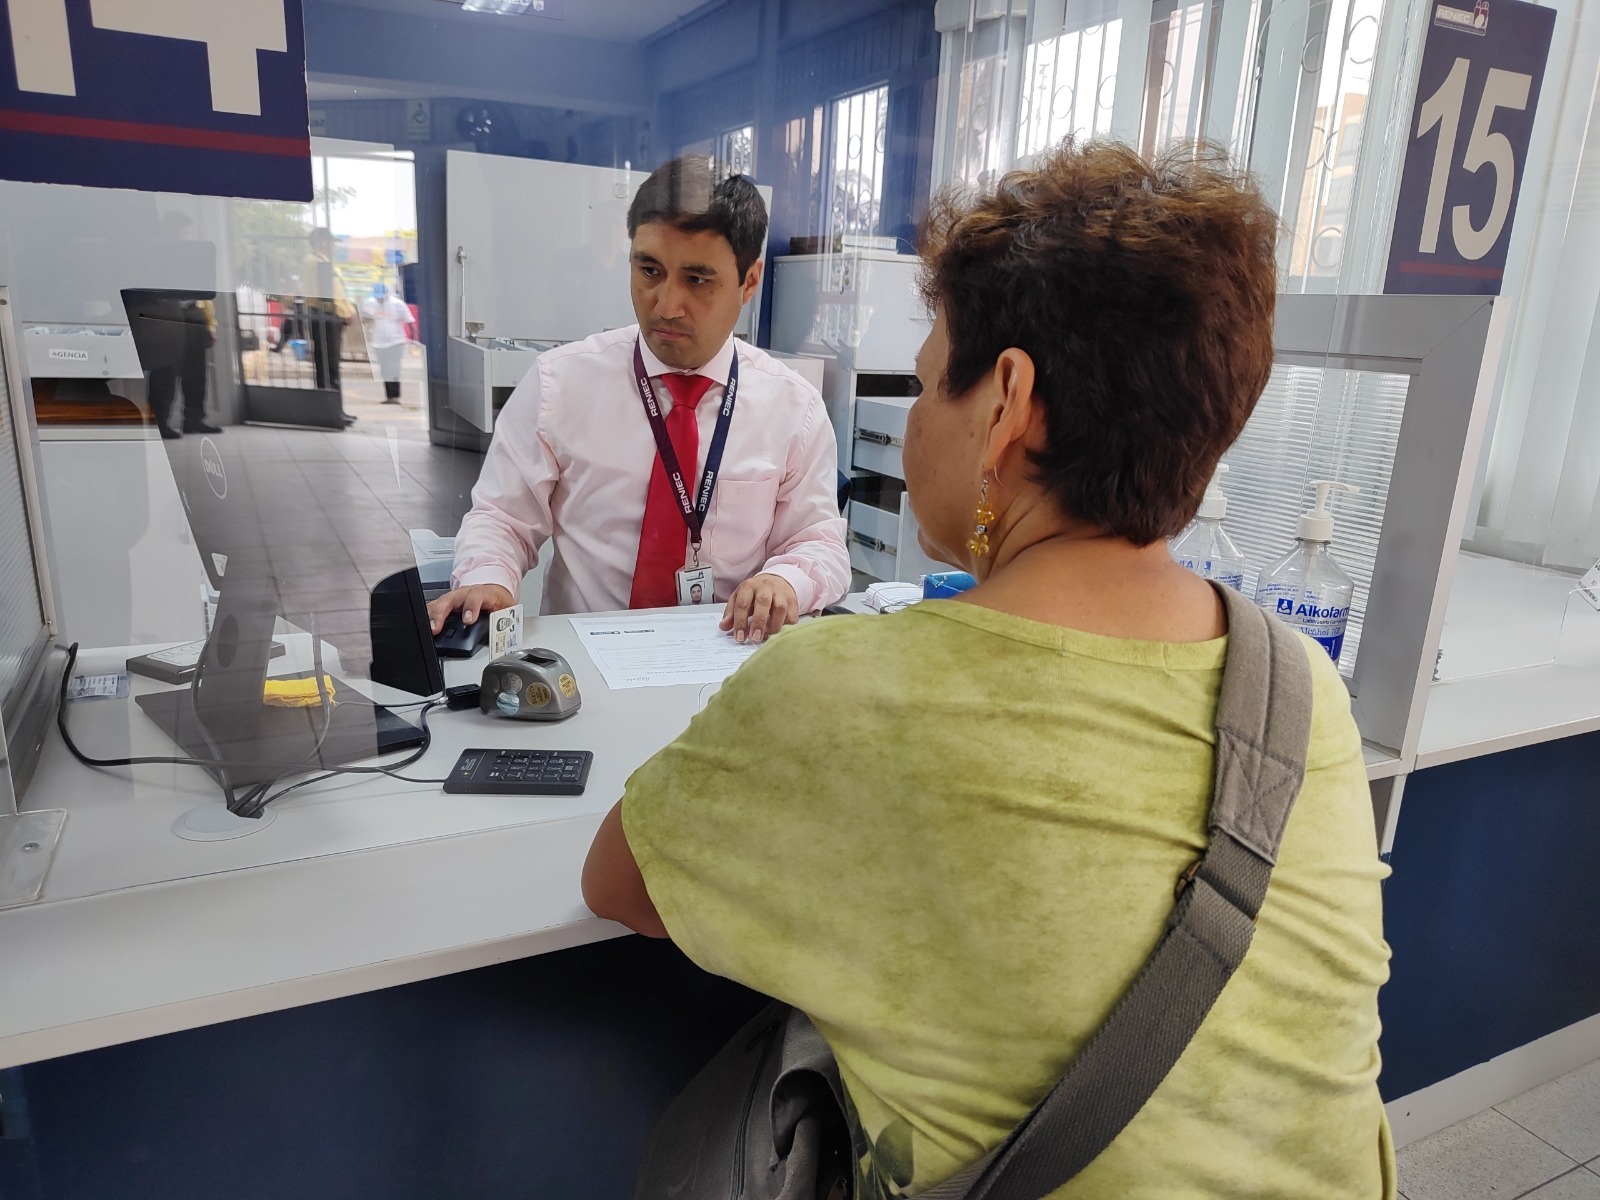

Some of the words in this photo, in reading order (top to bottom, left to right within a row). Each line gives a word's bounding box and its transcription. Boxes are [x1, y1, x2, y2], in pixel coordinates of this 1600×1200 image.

[1437, 8, 1470, 24] RENIEC
[1417, 57, 1532, 260] 15
[641, 377, 658, 417] RENIEC
[723, 378, 736, 416] RENIEC
[204, 459, 223, 478] DELL
[673, 472, 692, 514] RENIEC
[698, 470, 714, 512] RENIEC
